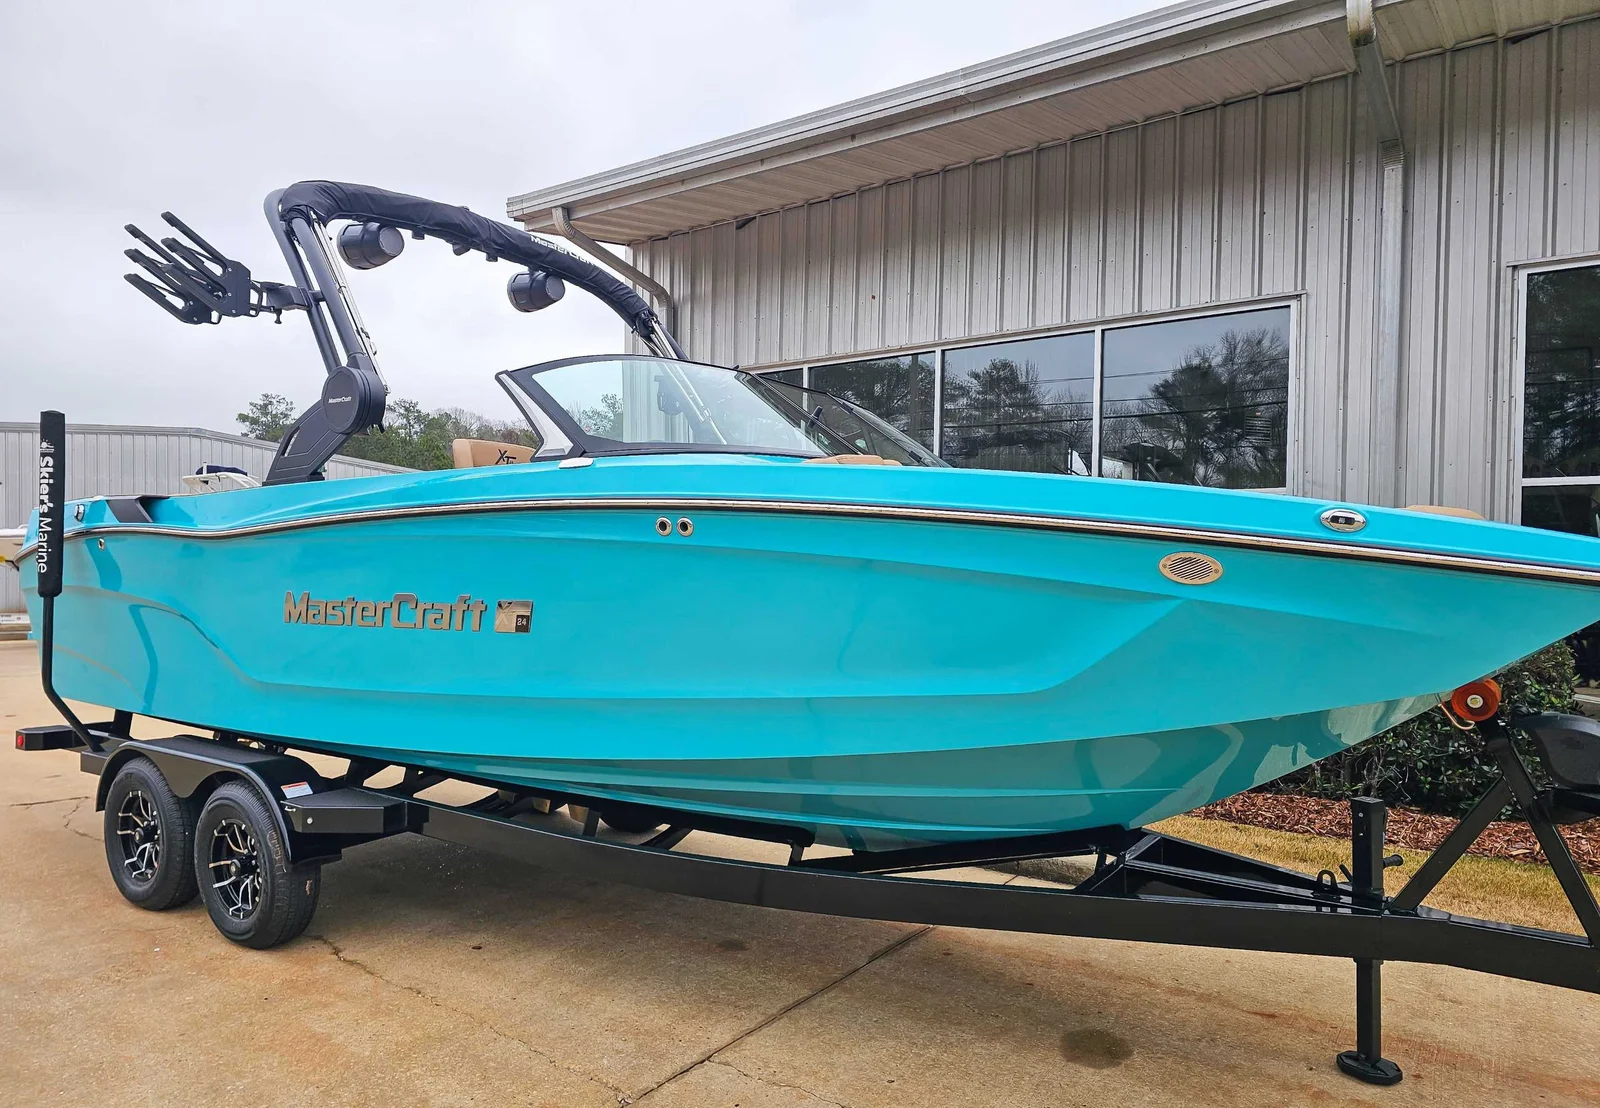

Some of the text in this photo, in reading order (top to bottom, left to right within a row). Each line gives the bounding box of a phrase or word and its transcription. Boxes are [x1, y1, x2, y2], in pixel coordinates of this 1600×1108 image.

[36, 456, 54, 573] Skier's Marine
[283, 590, 488, 632] MasterCraft
[516, 617, 528, 626] 24
